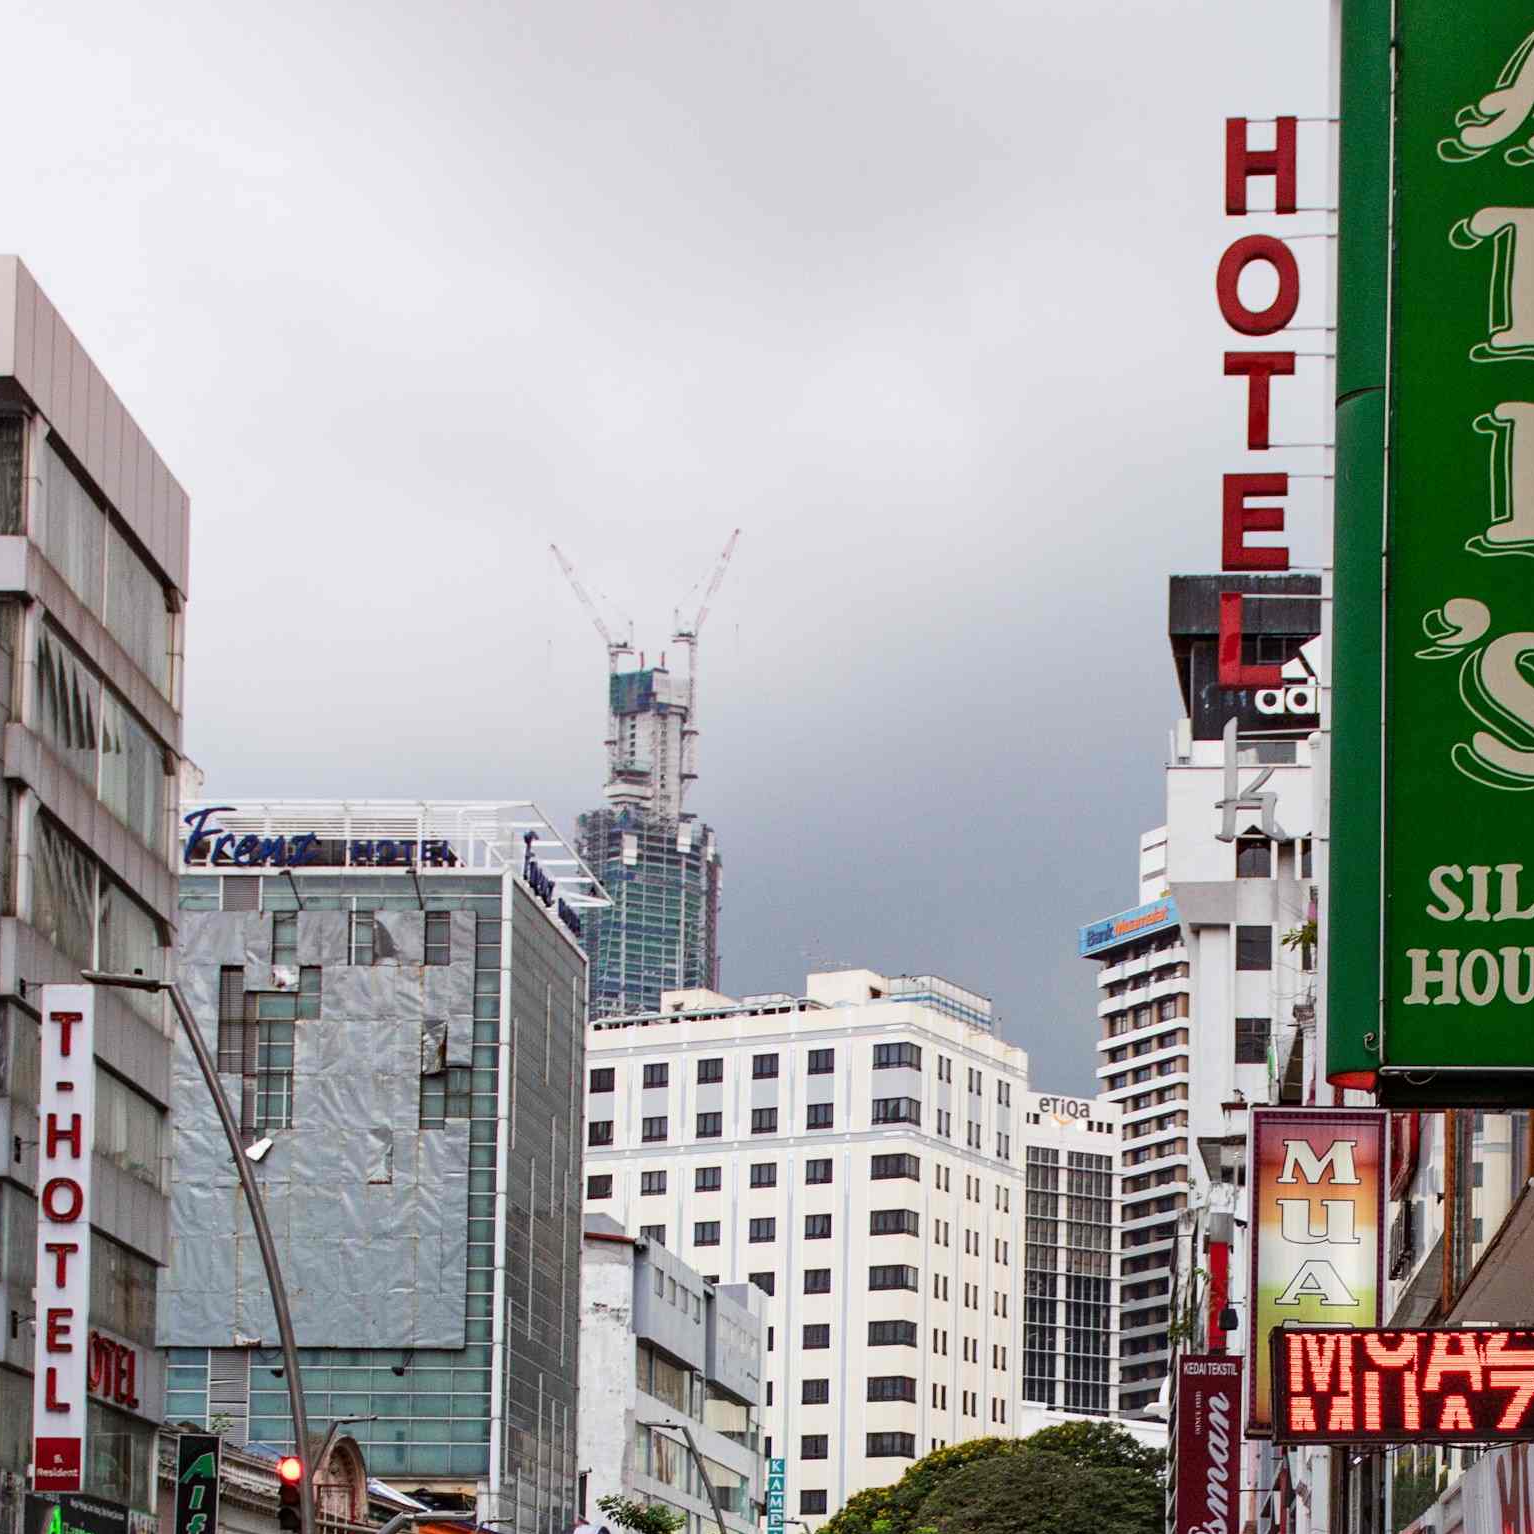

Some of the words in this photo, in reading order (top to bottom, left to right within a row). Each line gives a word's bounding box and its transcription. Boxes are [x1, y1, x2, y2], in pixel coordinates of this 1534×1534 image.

[1216, 116, 1300, 690] HOTEL
[42, 1011, 84, 1414] T-HOTEL
[1274, 1138, 1362, 1328] MUA
[1183, 1362, 1207, 1376] KEDAI
[1207, 1362, 1238, 1377] TEKSTIL
